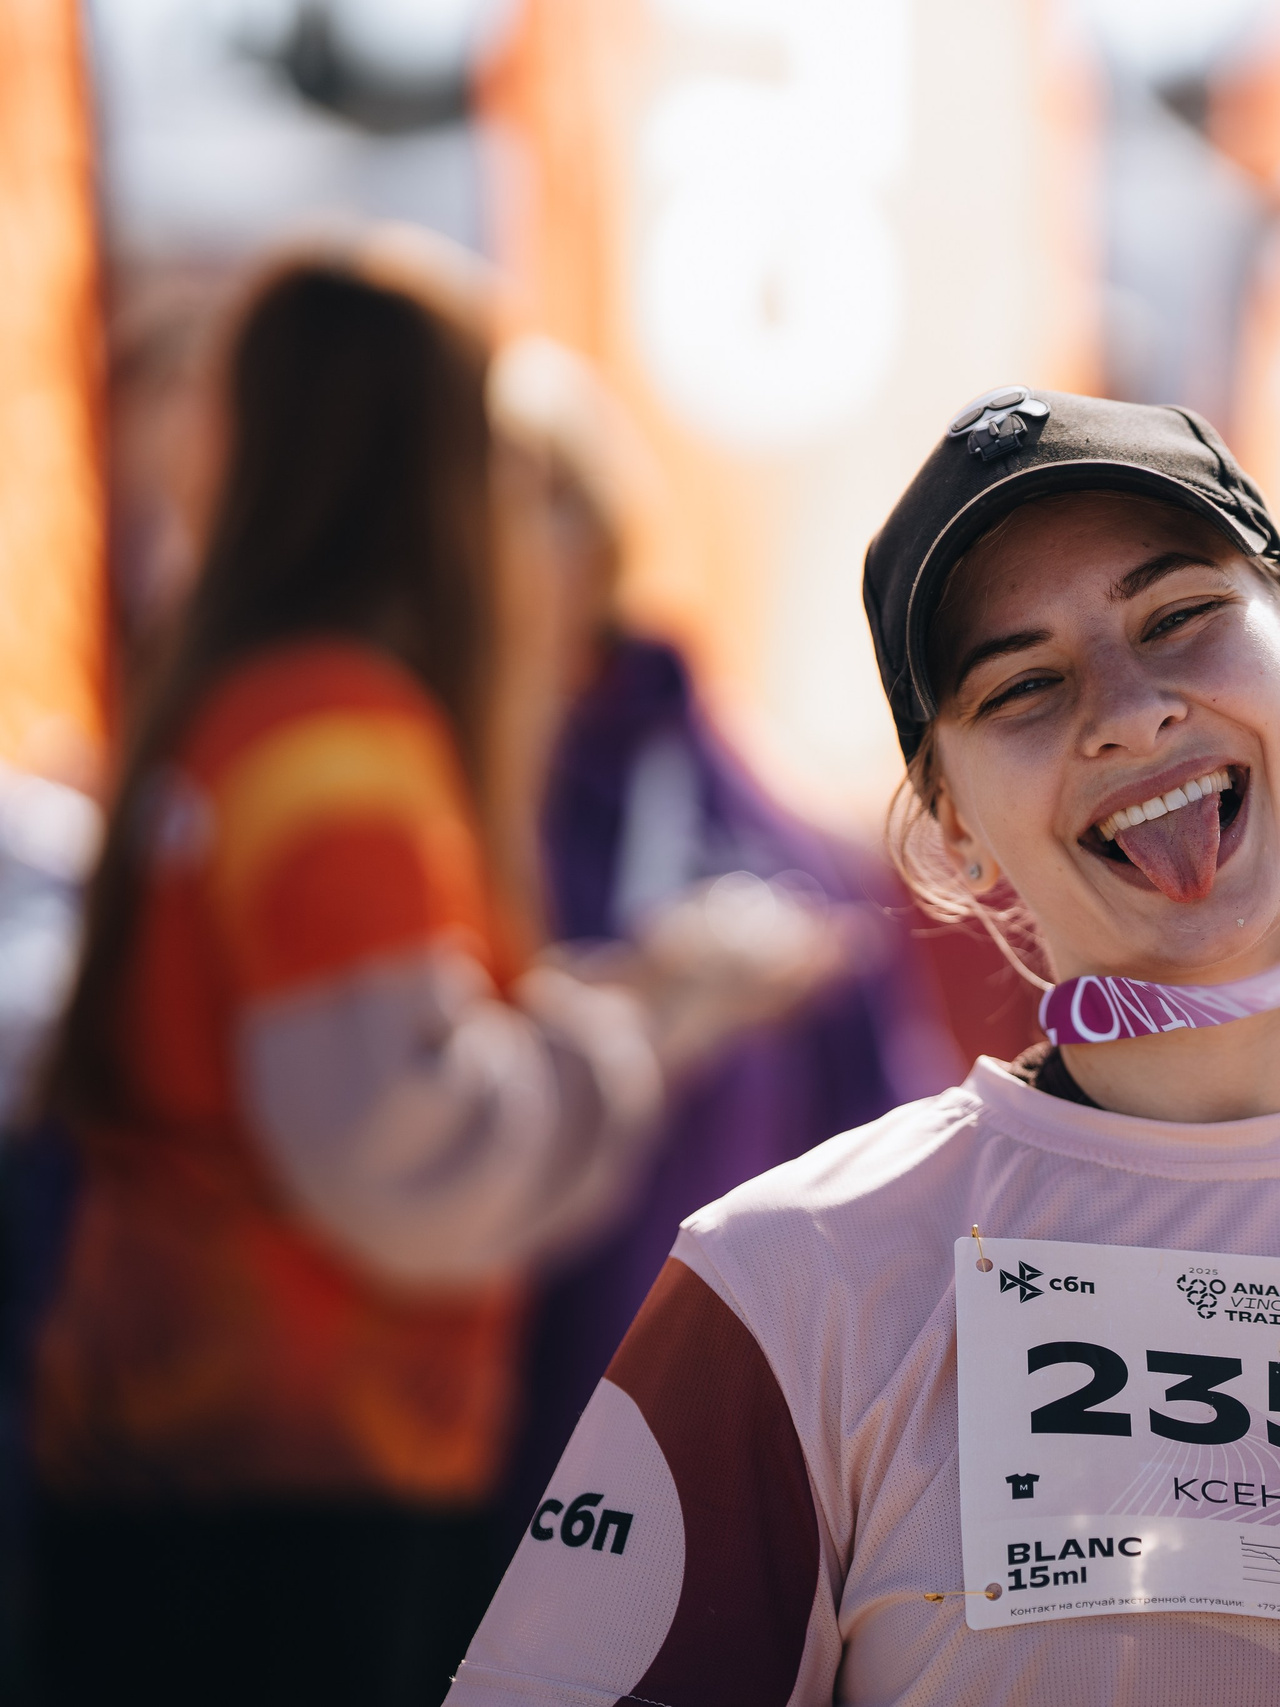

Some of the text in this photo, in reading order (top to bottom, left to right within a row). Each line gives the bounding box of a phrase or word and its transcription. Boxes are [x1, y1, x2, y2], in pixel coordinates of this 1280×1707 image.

[1188, 1267, 1219, 1276] 2025
[1049, 1275, 1096, 1295] сбп
[1019, 1483, 1029, 1492] M
[530, 1492, 634, 1556] сбп
[1007, 1537, 1143, 1566] BLANC
[1007, 1565, 1087, 1591] 15ml
[1010, 1596, 1245, 1617] Контакт на случай экстренной ситуации:
